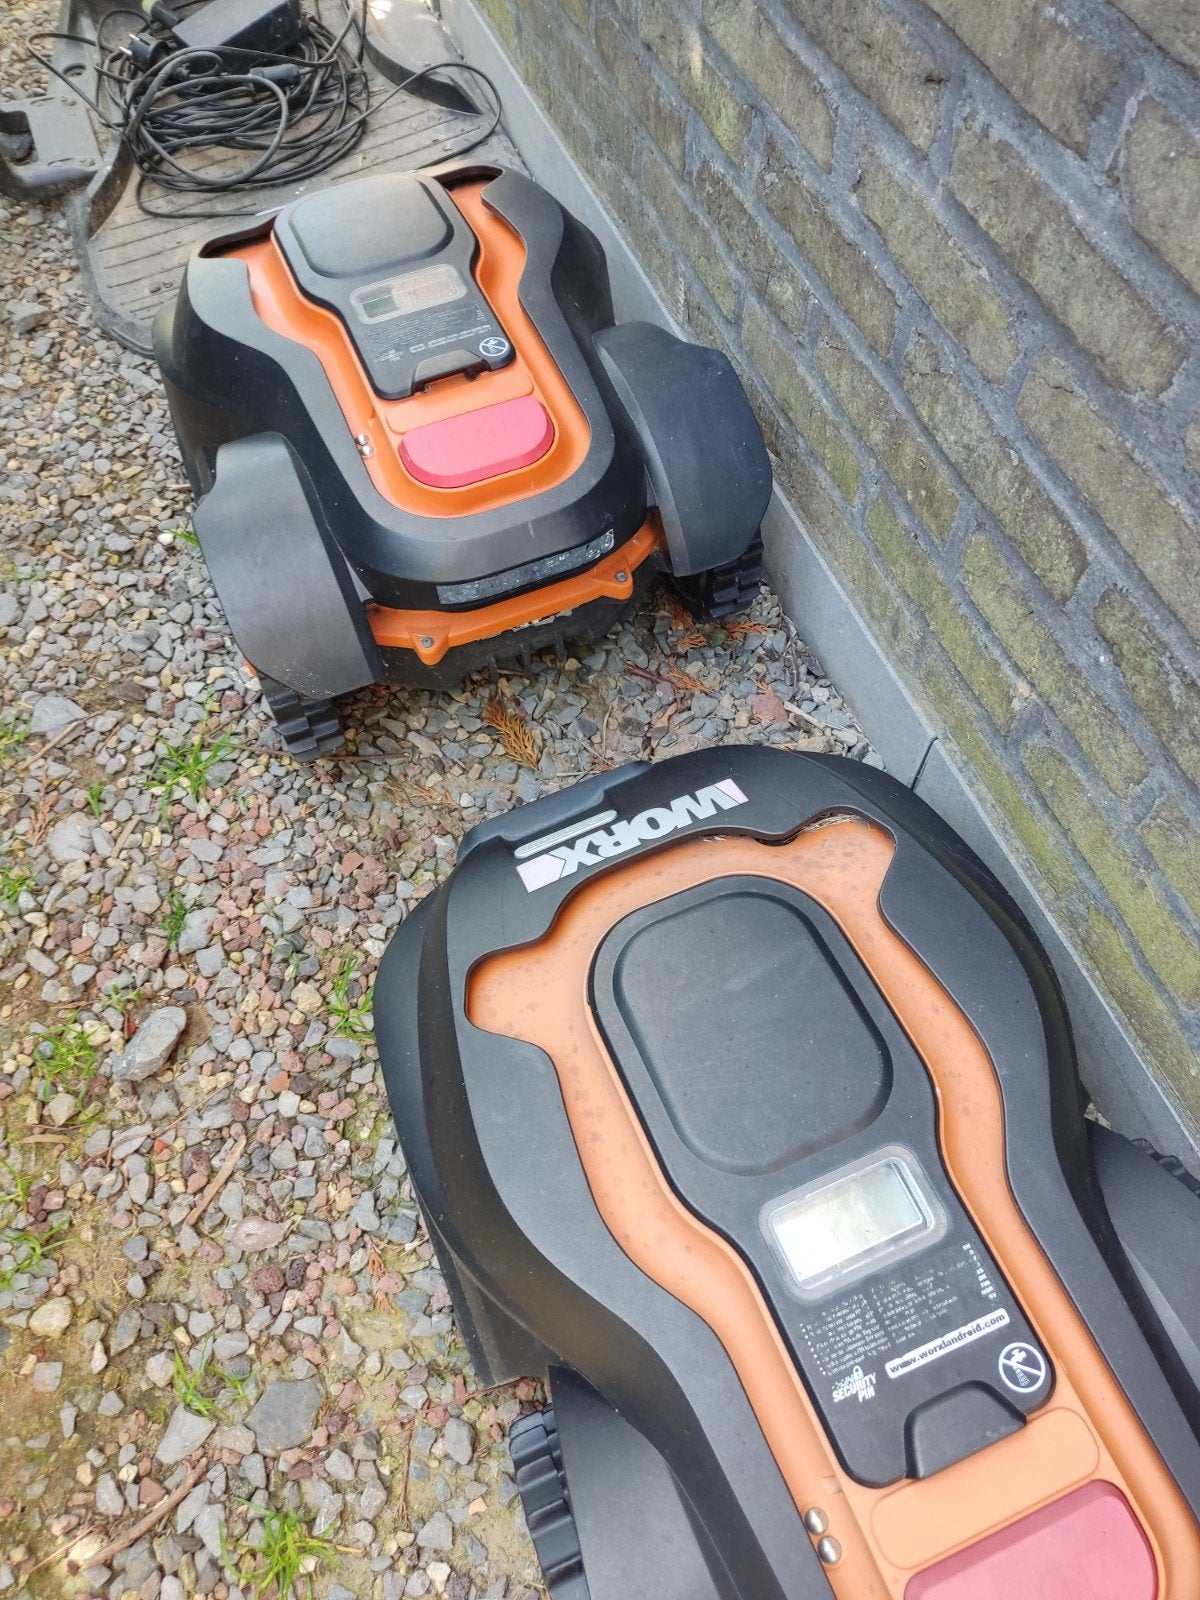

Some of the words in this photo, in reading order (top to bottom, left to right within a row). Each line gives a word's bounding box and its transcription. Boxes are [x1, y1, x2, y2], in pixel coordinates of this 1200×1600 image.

[546, 784, 741, 879] WORX
[832, 1372, 876, 1402] SECURITY
[857, 1385, 876, 1402] PIN
